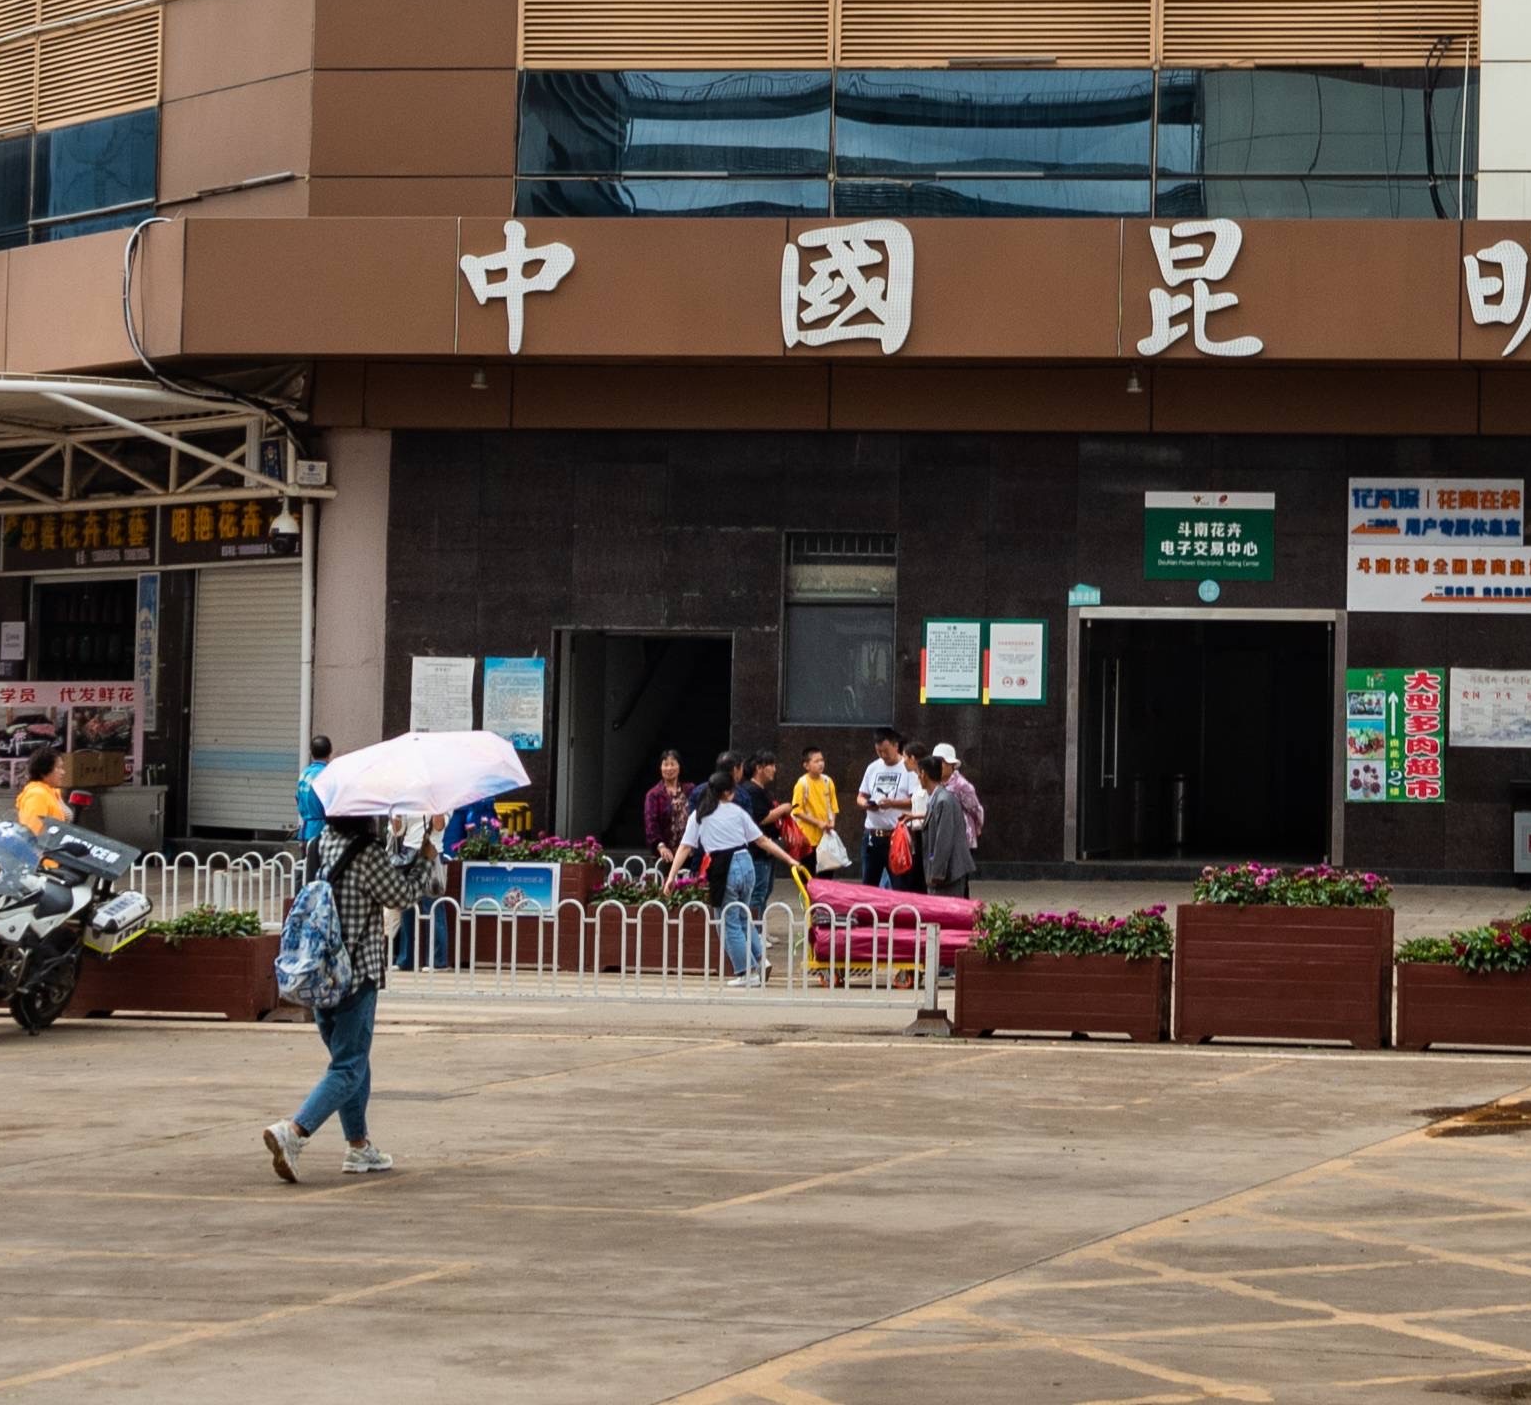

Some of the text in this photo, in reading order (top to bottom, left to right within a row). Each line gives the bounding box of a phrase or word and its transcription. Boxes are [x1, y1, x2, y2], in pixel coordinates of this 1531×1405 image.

[1177, 521, 1242, 538] 斗南花卉
[1160, 540, 1259, 557] 电子交易中心
[60, 687, 135, 703] 代发鲜花
[1404, 670, 1441, 800] 大型多肉超市
